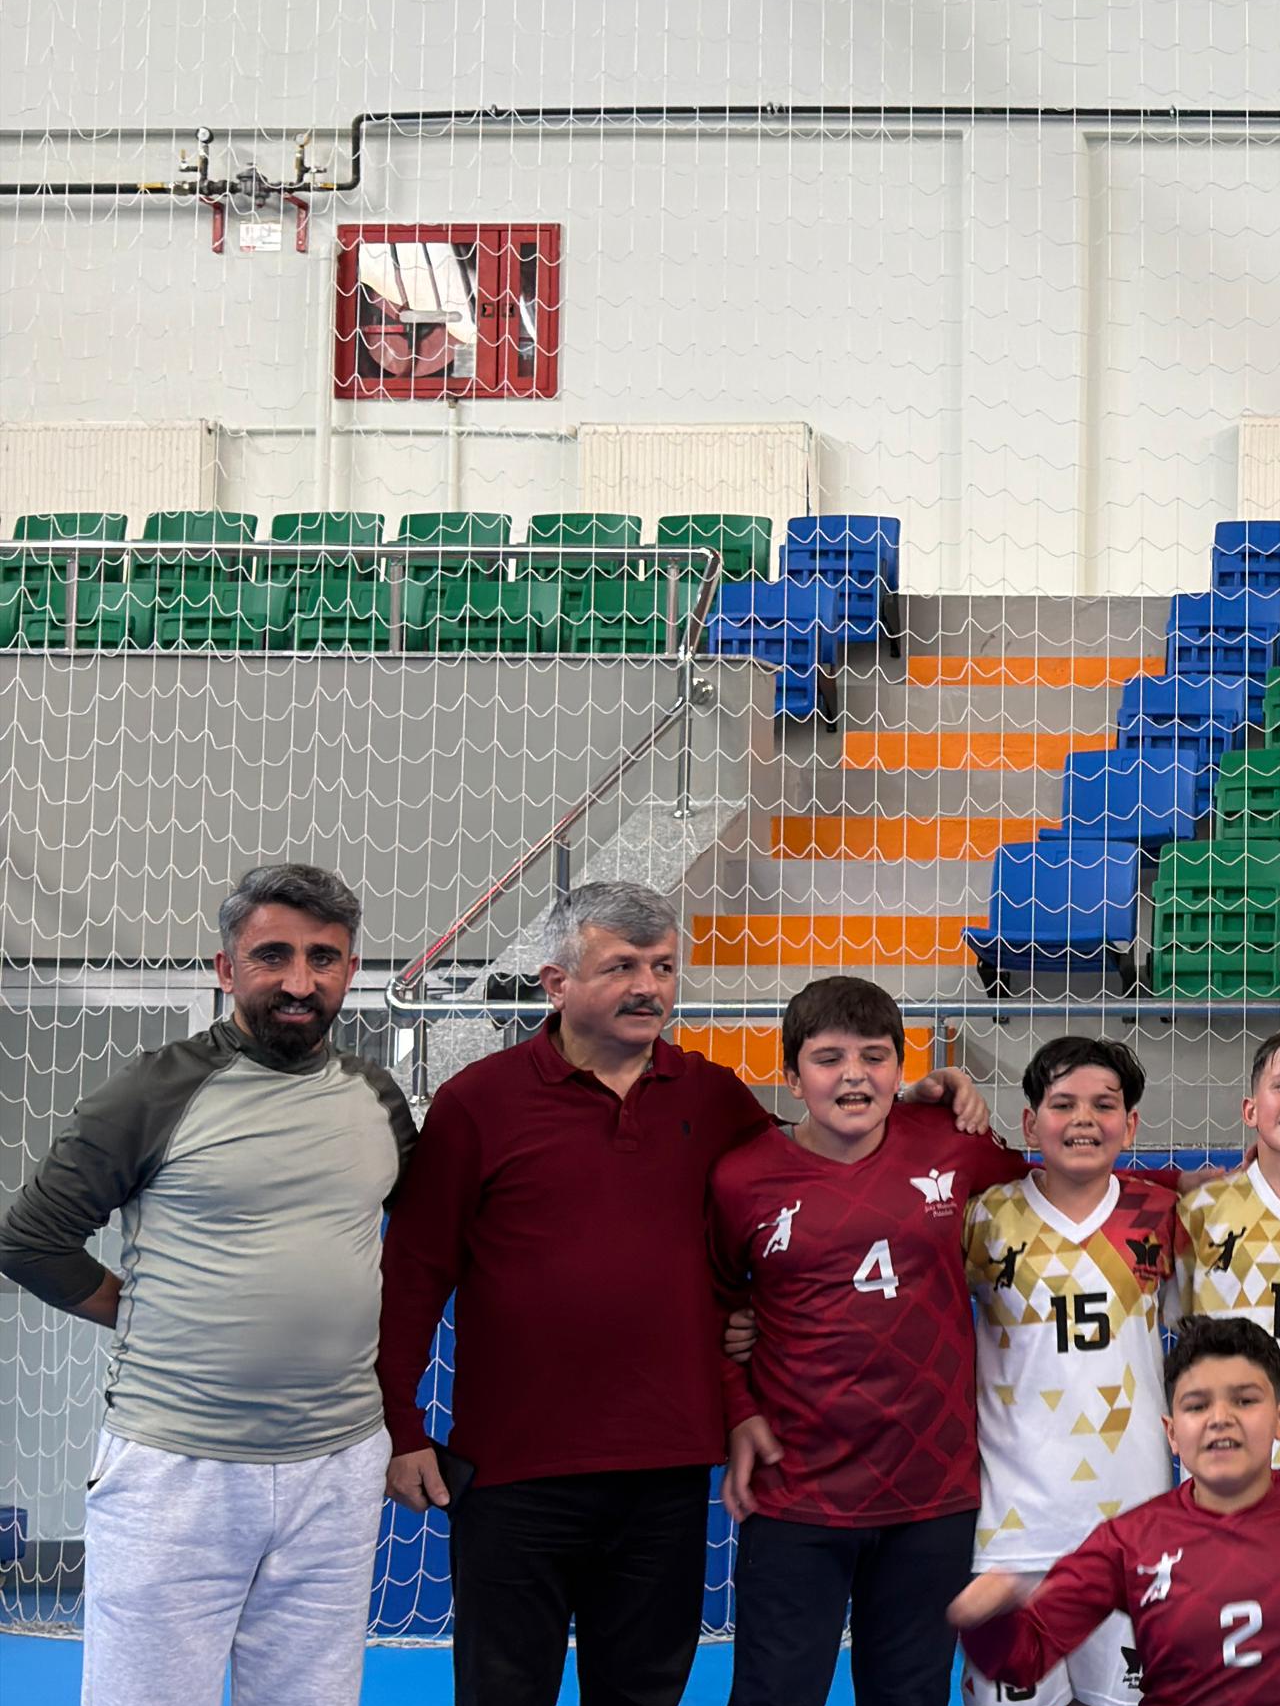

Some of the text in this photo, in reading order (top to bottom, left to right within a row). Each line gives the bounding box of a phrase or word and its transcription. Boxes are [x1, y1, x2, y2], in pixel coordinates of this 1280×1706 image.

[853, 1239, 900, 1300] 4
[1050, 1292, 1111, 1354] 15
[1218, 1600, 1263, 1669] 2
